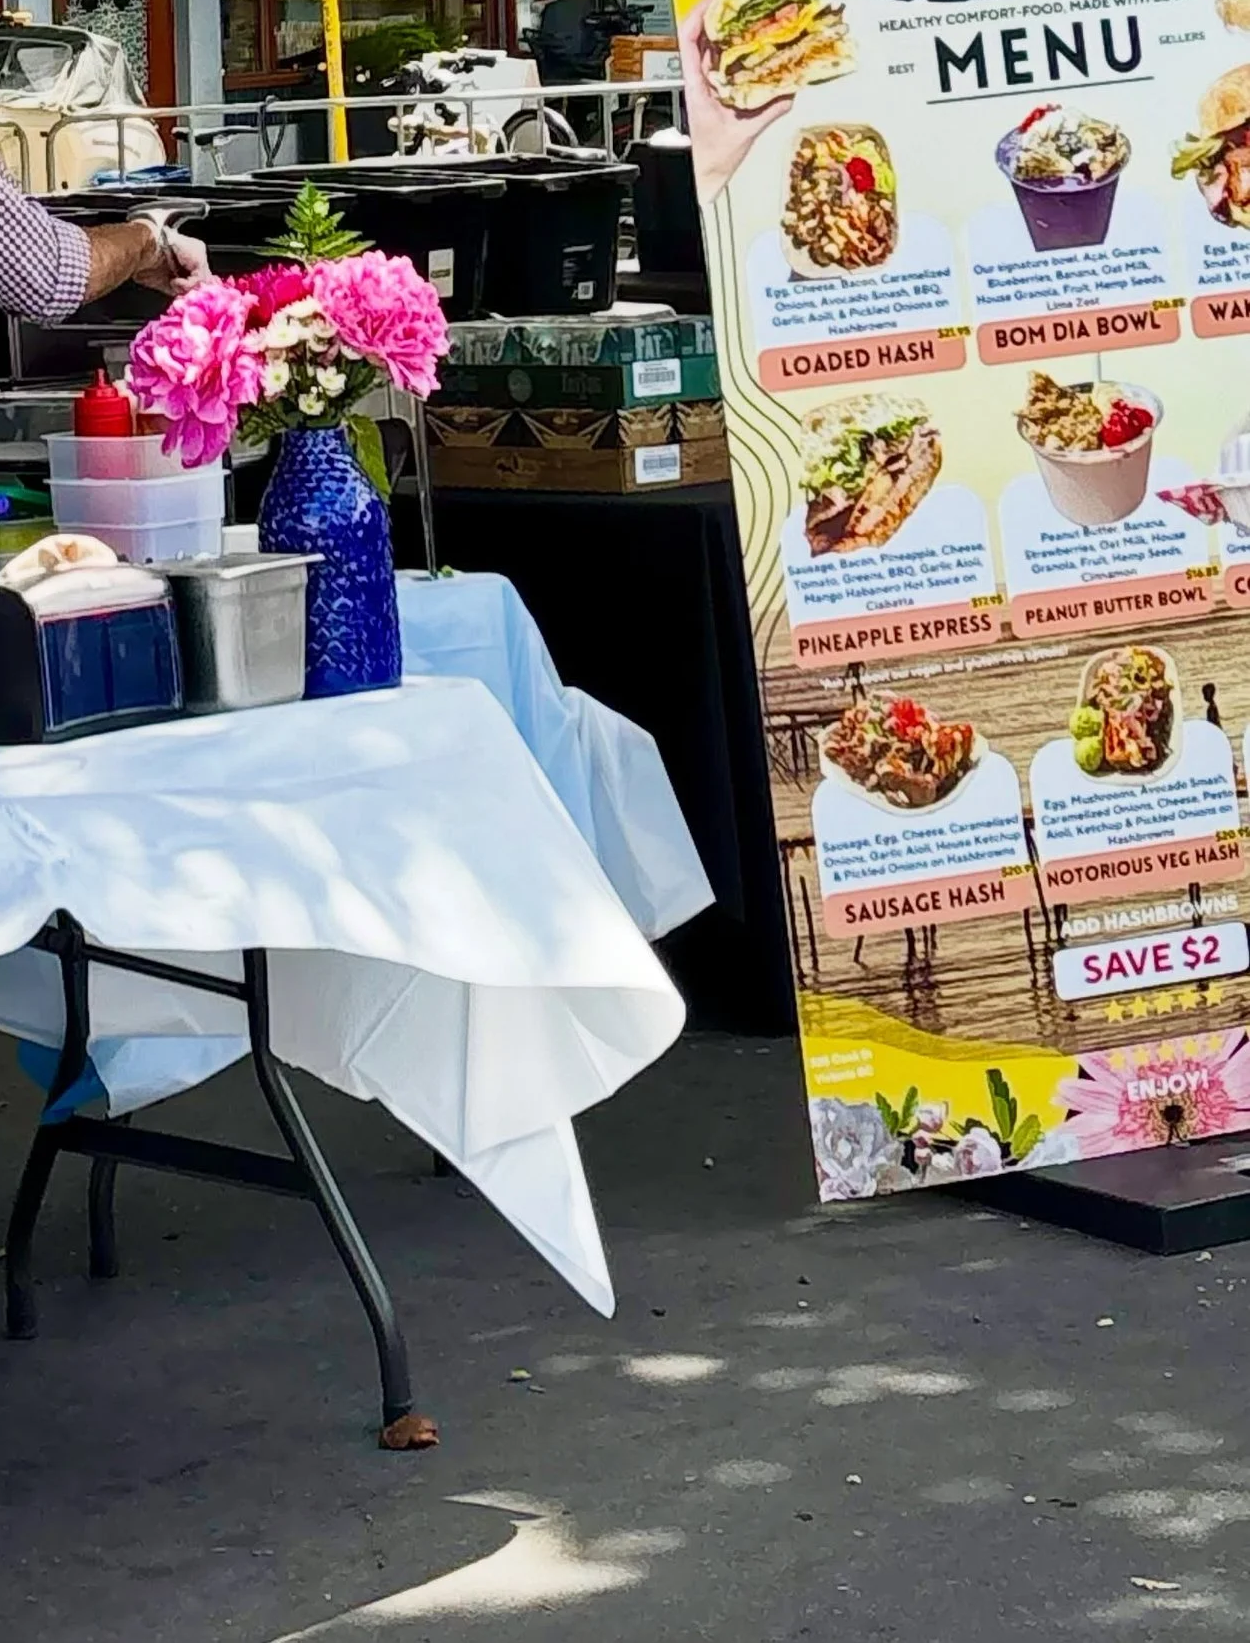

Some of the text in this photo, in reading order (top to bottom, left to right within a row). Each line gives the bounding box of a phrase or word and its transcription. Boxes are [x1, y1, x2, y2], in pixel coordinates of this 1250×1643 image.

[879, 14, 942, 32] HEALTHY
[945, 2, 1067, 26] COMFORT-FOOD,
[1159, 31, 1205, 45] SELLERS
[935, 15, 1141, 92] MENU
[888, 62, 914, 75] BEST
[881, 266, 951, 284] Caramelized
[973, 264, 994, 276] Our
[998, 259, 1048, 274] signature
[1102, 263, 1122, 275] Oat
[1225, 273, 1232, 282] &
[821, 294, 868, 306] Avocado
[976, 292, 1011, 306] House
[1095, 279, 1127, 293] Hemp
[772, 315, 804, 327] Garlic
[839, 310, 845, 319] &
[849, 302, 890, 317] Pickled
[893, 299, 933, 313] Onions
[935, 299, 949, 307] on
[1047, 297, 1100, 311] Lime Zest
[829, 320, 897, 336] Hashbrowns
[995, 310, 1162, 349] BOM DIA BOWL
[634, 327, 662, 360] FAT
[782, 341, 935, 377] LOADED HASH
[1040, 531, 1079, 542] Peanut
[1100, 539, 1120, 550] Oat
[1151, 531, 1186, 542] House
[1112, 551, 1145, 564] Hemp
[920, 562, 951, 574] Garlic
[1081, 568, 1137, 582] Cinnamon
[804, 574, 976, 606] Mango Habanero Hot Sauce on
[866, 597, 914, 611] Ciabatta
[1026, 587, 1207, 625] PEANUT BUTTER BOWL
[798, 614, 992, 656] PINEAPPLE EXPRESS
[1141, 780, 1187, 794] Avocado
[949, 815, 1019, 834] Caramelized
[1041, 808, 1110, 826] Caramelized
[1077, 821, 1123, 835] Ketchup
[1125, 818, 1133, 828] &
[1135, 812, 1175, 826] Pickled
[1178, 807, 1216, 820] Onions
[1219, 805, 1233, 813] on
[870, 850, 901, 862] Garlic
[936, 839, 971, 851] House
[974, 831, 1021, 845] Ketchup
[1107, 829, 1175, 845] Hashbrowns
[833, 847, 1016, 882] & Pickled Onions on Hashbrowns
[1046, 842, 1240, 888] NOTORIOUS VEG HASH
[845, 881, 1005, 924] SAUSAGE HASH
[1061, 894, 1239, 939] ADD HASHBROWNS
[1083, 935, 1220, 984] SAVE $2
[1127, 1068, 1209, 1102] ENJOY!
